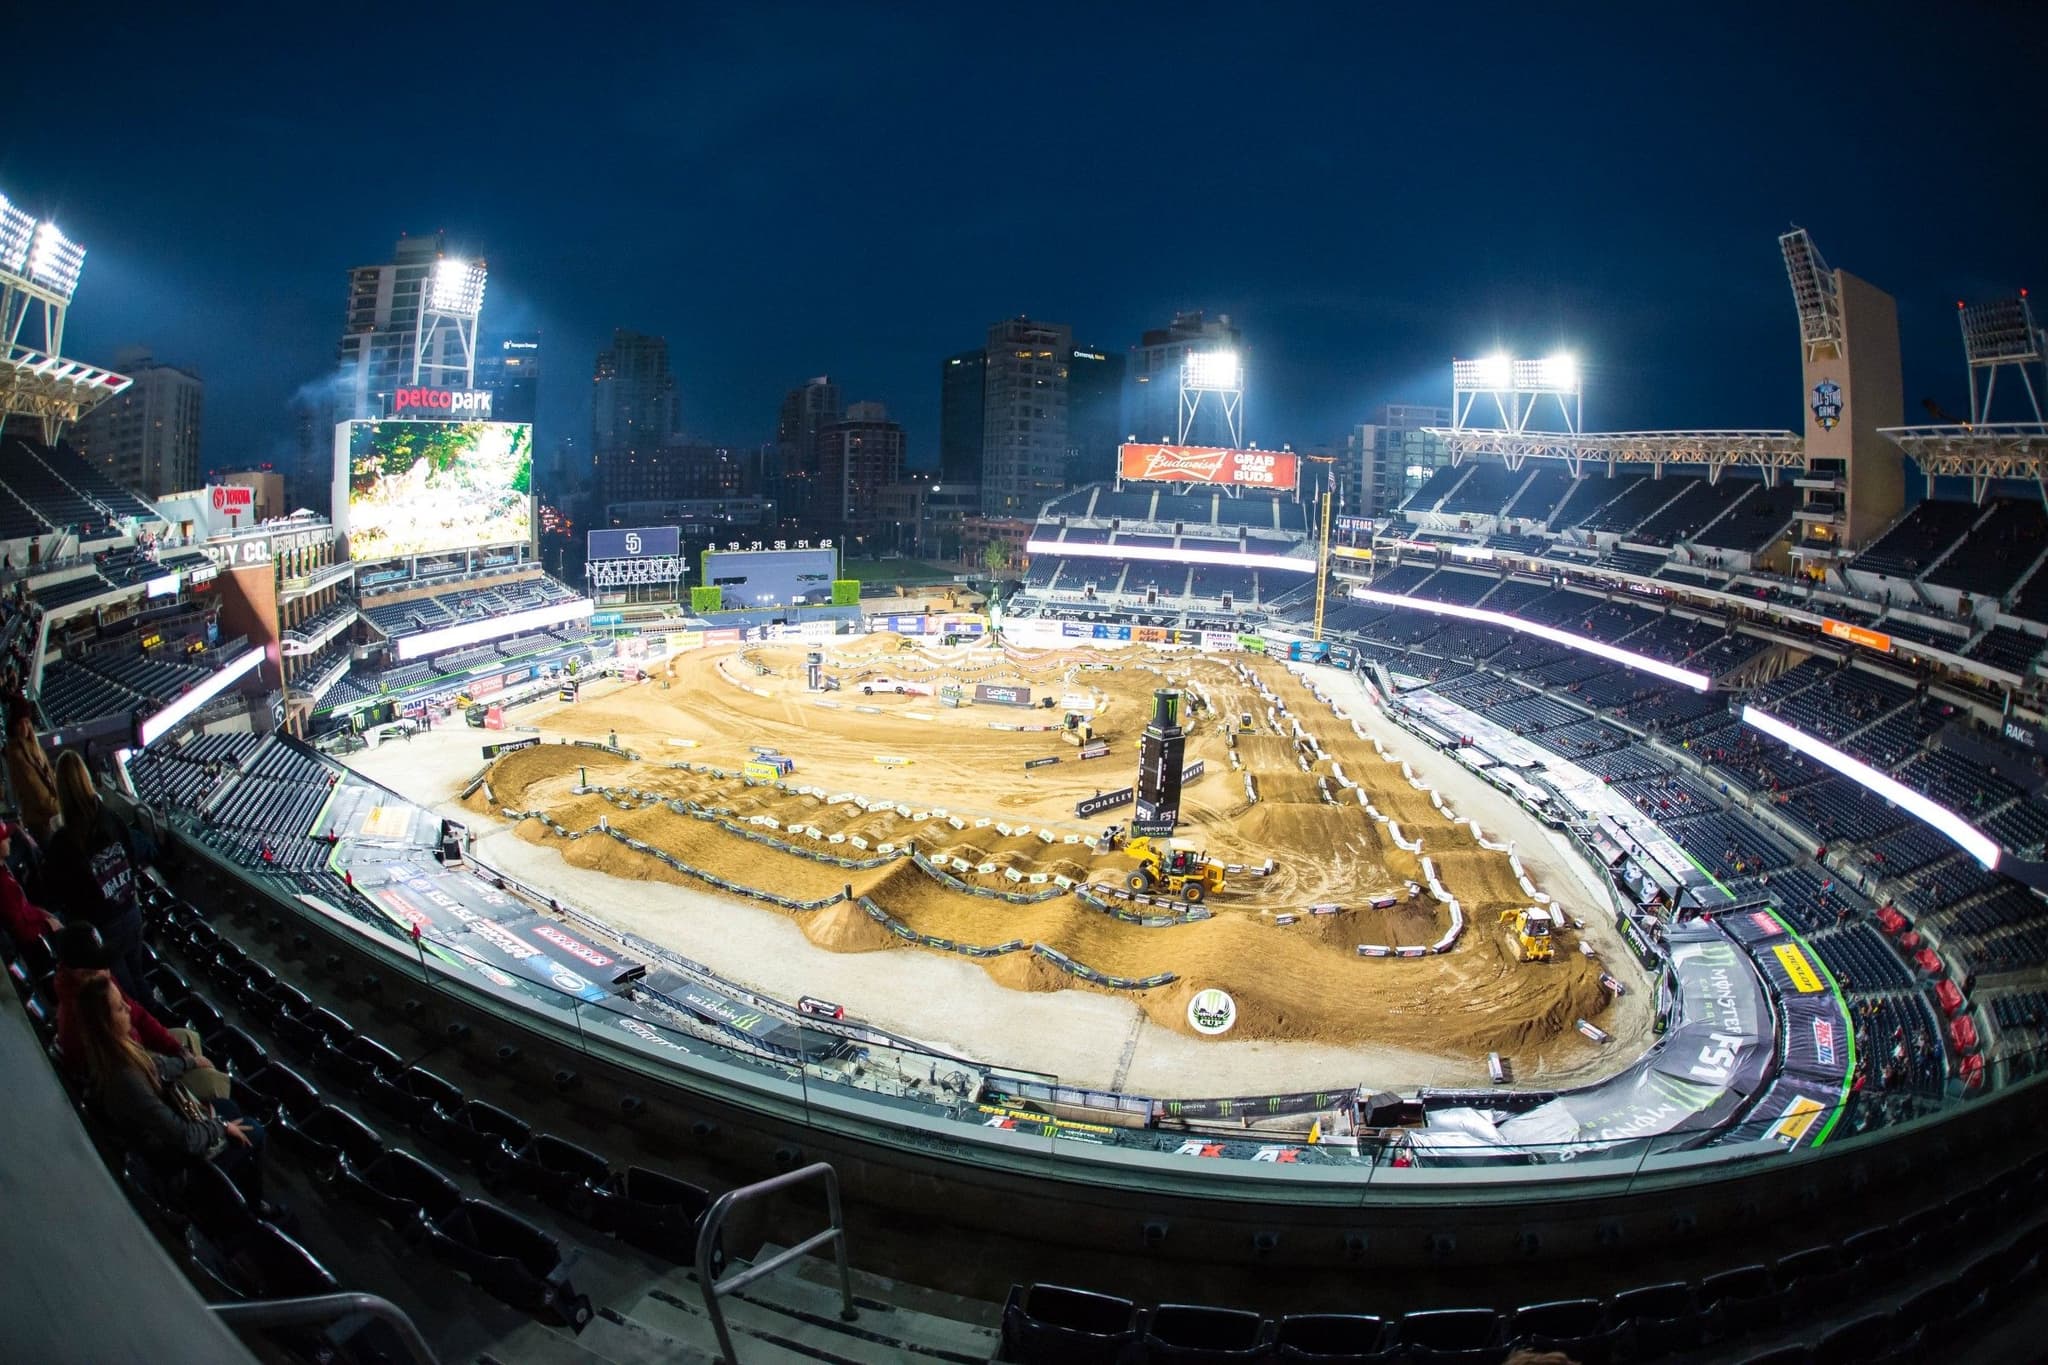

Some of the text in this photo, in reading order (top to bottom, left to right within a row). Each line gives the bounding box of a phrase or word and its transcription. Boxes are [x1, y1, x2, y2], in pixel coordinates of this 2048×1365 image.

[1146, 454, 1275, 471] Budweiser GRAB
[1234, 471, 1273, 482] BUDS
[226, 489, 251, 504] TOYOTA
[1339, 519, 1372, 531] LAS VEGAS
[243, 541, 271, 562] CO.
[708, 539, 832, 552] 6 19 31 35 51 42
[584, 557, 690, 577] NATIONAL
[594, 570, 679, 587] UNIVERSITY
[986, 688, 1016, 697] GoPro
[1095, 792, 1133, 809] OAKLEY
[1787, 953, 1814, 989] DUNLOP
[1710, 968, 1743, 1034] MONSTER
[1813, 1017, 1836, 1065] AMSOIL
[1690, 1033, 1744, 1078] FS1
[1009, 1110, 1050, 1123] FINALS
